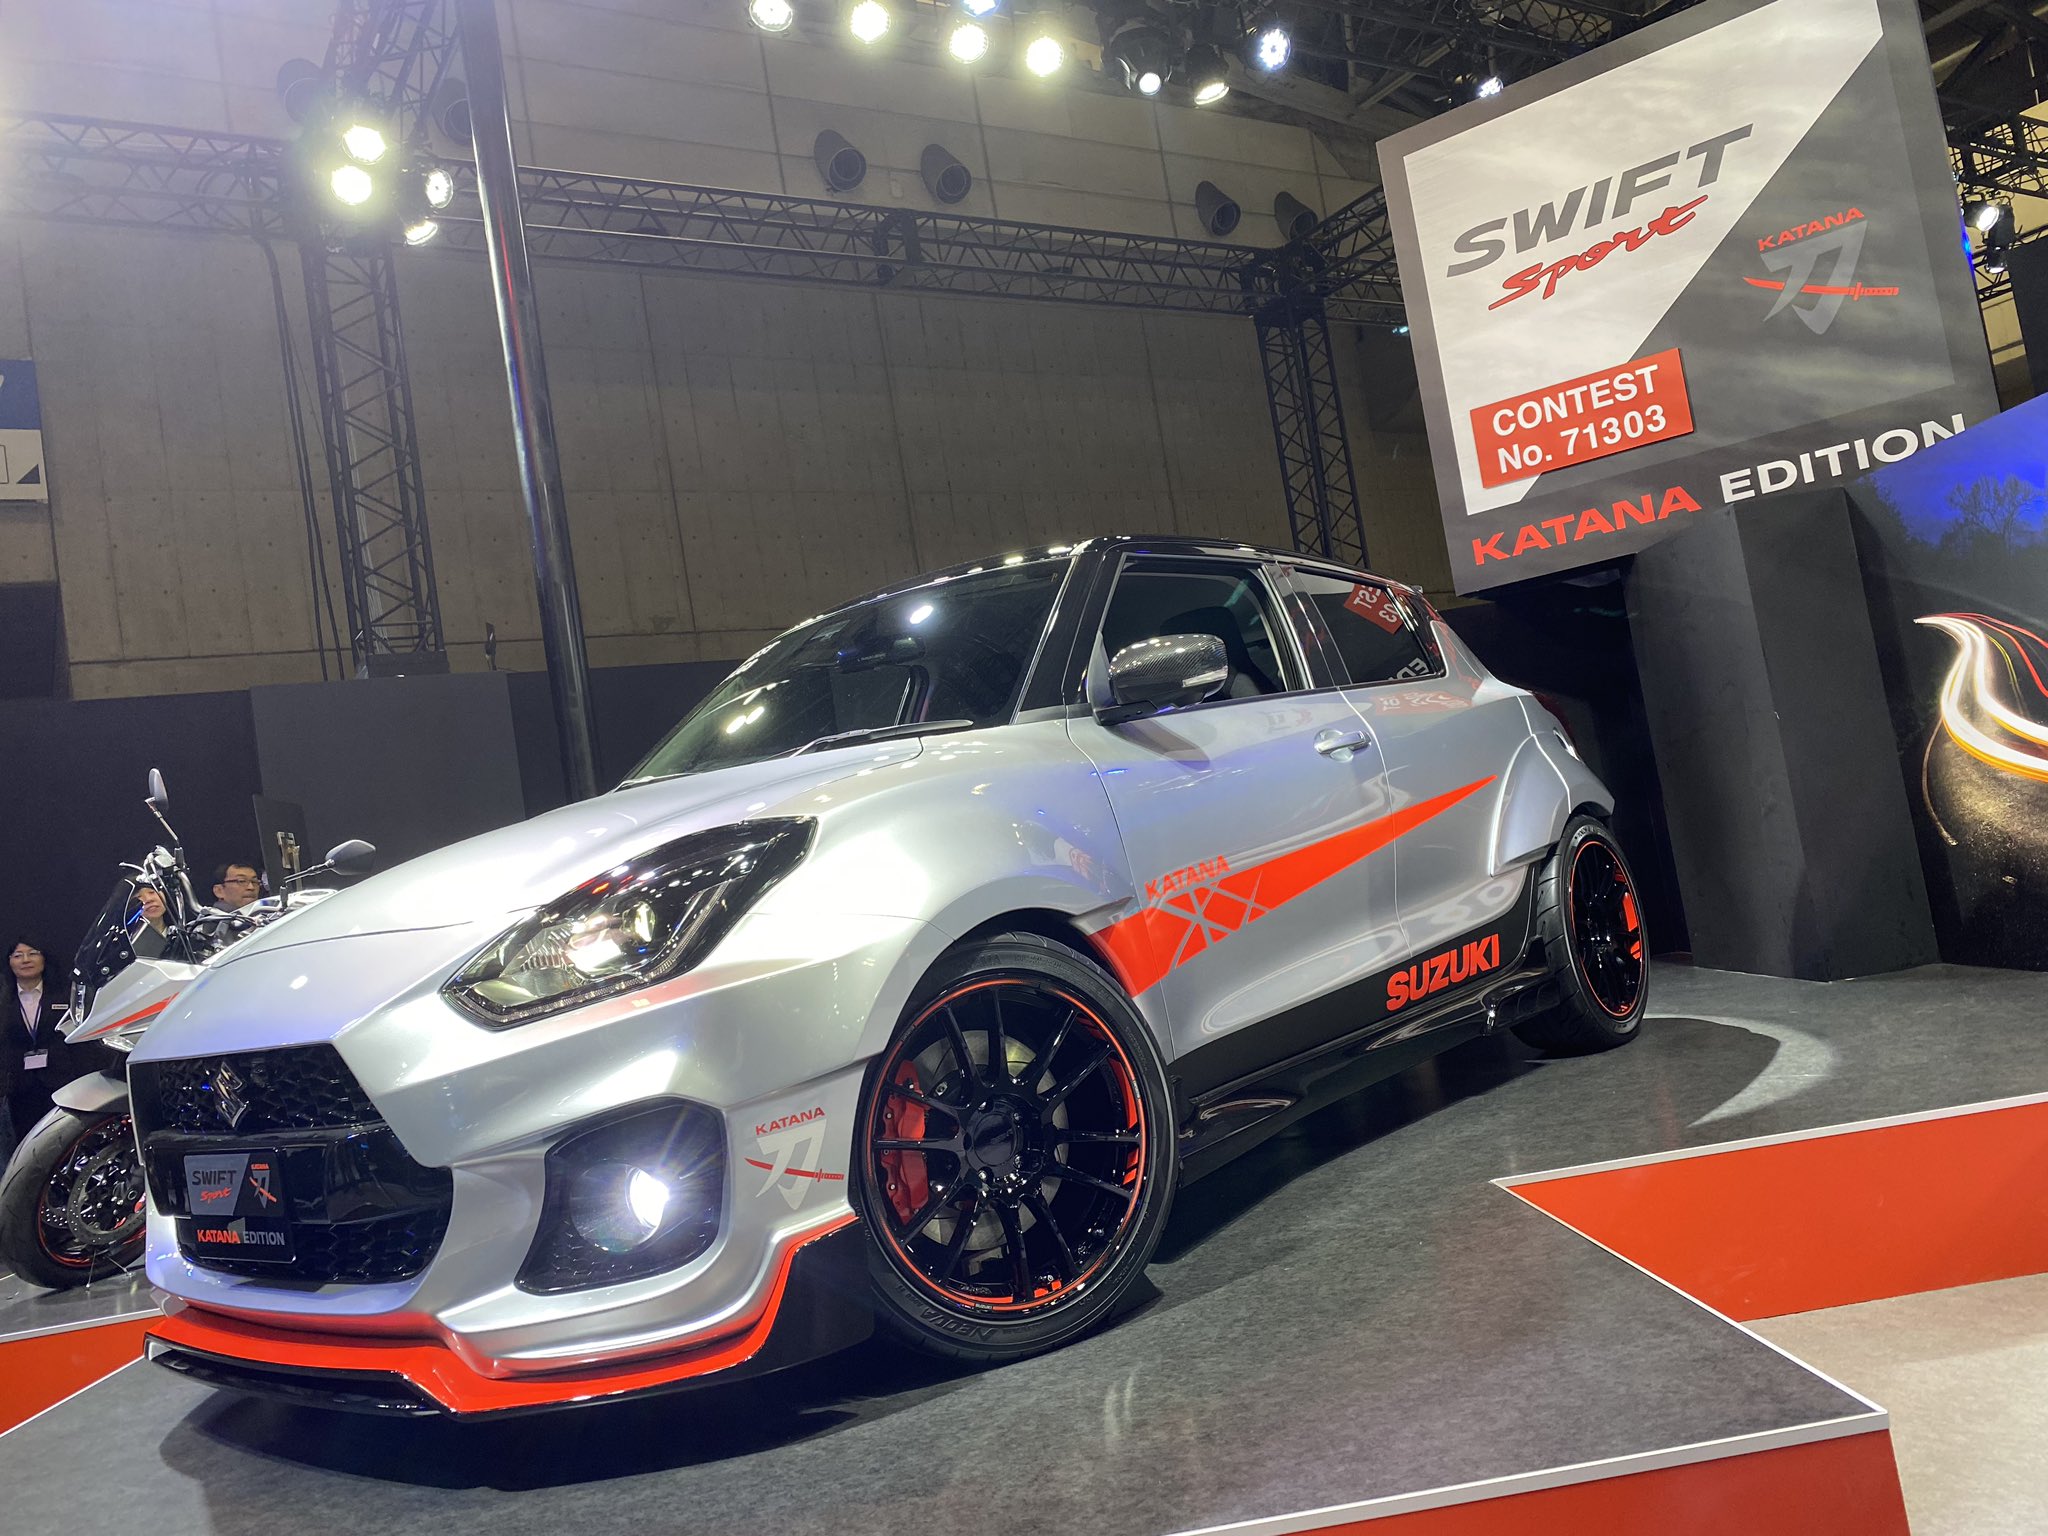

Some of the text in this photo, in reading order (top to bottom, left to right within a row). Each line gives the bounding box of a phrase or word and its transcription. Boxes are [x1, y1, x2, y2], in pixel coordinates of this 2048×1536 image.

[1447, 123, 1754, 278] SWIFT
[1757, 207, 1865, 251] KATANA
[1488, 195, 1709, 310] Sport
[1492, 364, 1659, 436] CONTEST
[1497, 404, 1667, 474] No. 71303
[1472, 413, 1966, 565] KATANA EDITION
[1144, 854, 1231, 903] KATANA
[1385, 933, 1500, 1011] SUZUKI
[755, 1106, 826, 1136] KATANA
[192, 1170, 237, 1185] SWIFT
[197, 1229, 285, 1245] KATANA EDITION
